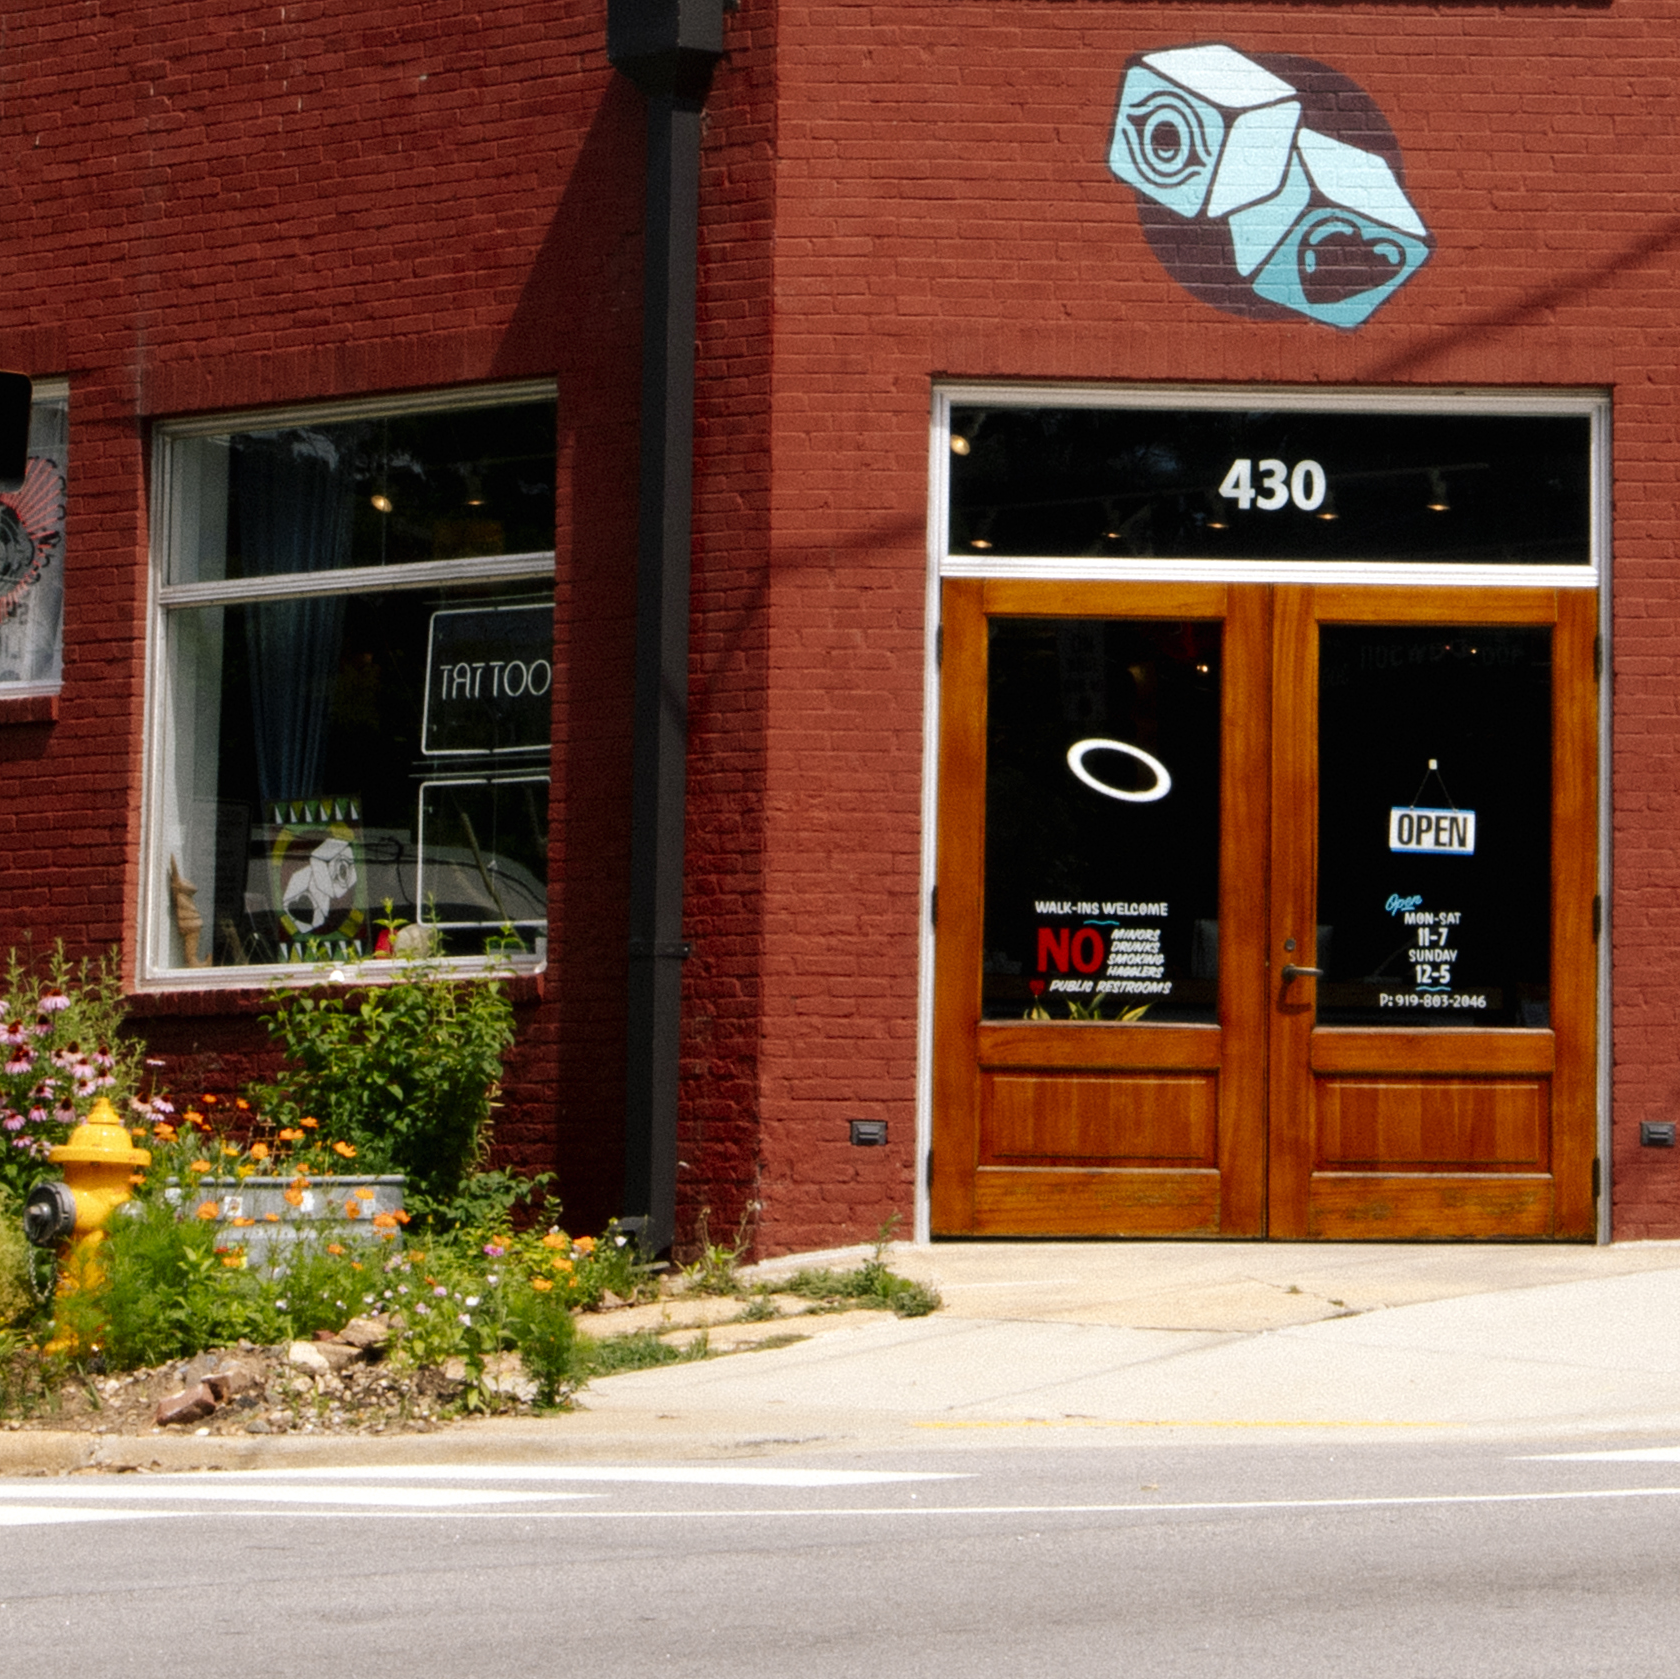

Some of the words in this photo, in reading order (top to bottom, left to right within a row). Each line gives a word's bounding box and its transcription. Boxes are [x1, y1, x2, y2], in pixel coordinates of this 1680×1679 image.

[1218, 458, 1326, 511] 430
[440, 659, 552, 700] TATTOO
[1397, 813, 1468, 848] OPEN
[1035, 901, 1100, 915] WALK-INS
[1102, 902, 1168, 916] WELCOME
[1385, 893, 1422, 916] Open
[1404, 912, 1461, 925] MON-SAT
[1111, 928, 1161, 941] MINORS
[1417, 927, 1448, 946] 11-7
[1037, 927, 1104, 974] NO
[1111, 941, 1161, 953] DRUNKS
[1106, 953, 1164, 966] SMOKING
[1408, 949, 1458, 962] SUNDAY
[1415, 964, 1451, 984] 12-5
[1049, 979, 1094, 992] PUBLIC
[1096, 981, 1172, 994] RESTROOMS
[1379, 994, 1393, 1007] P:
